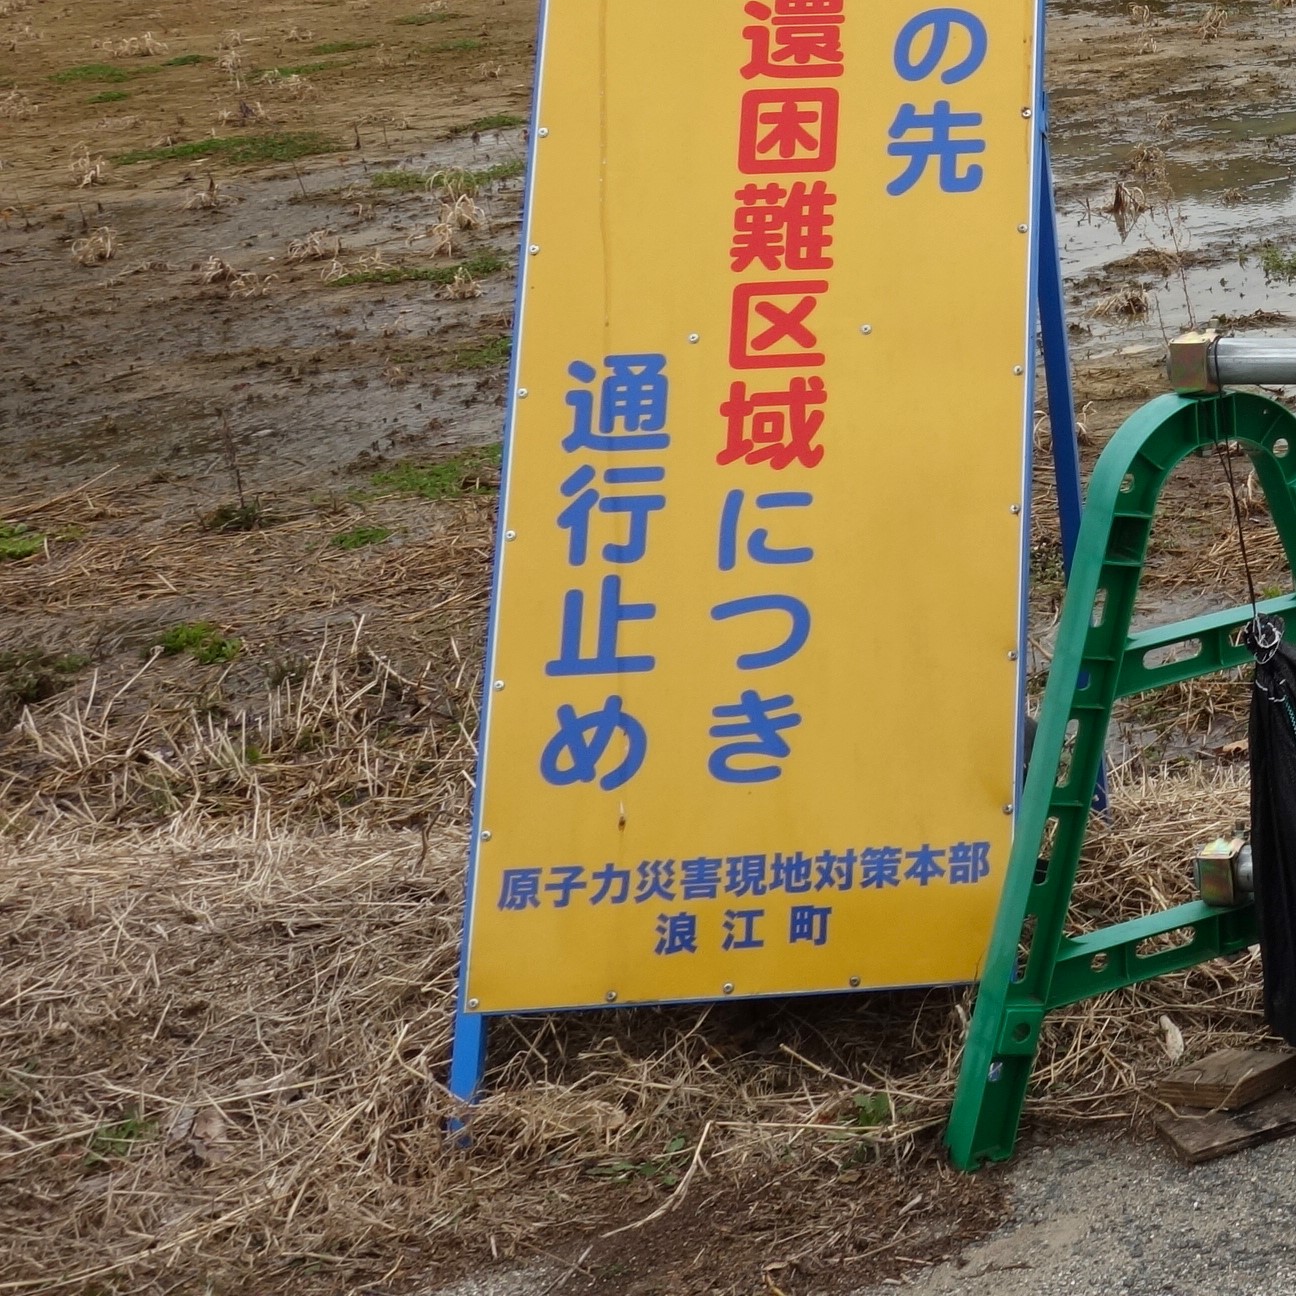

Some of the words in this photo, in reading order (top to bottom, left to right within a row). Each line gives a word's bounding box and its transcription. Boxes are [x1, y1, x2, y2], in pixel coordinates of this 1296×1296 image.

[540, 354, 670, 791] 通行止め
[498, 841, 990, 911] 原子力災害現地対策本部
[654, 905, 832, 955] 浪江町
